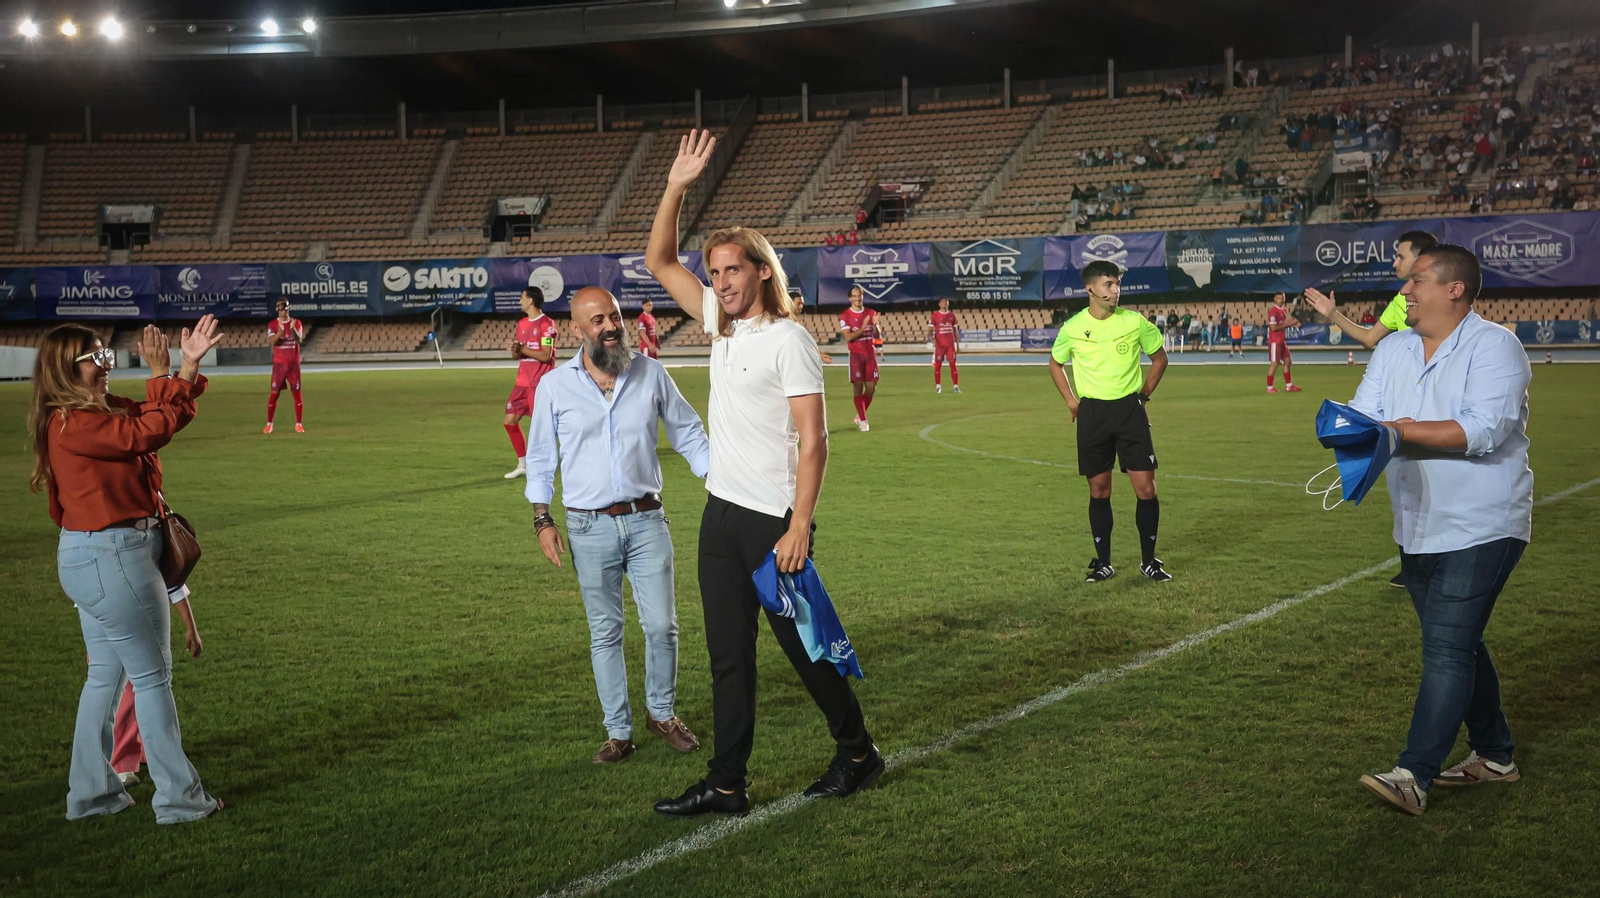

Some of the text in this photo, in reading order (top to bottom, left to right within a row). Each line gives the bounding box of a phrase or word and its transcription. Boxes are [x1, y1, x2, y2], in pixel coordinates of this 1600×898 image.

[1259, 235, 1285, 243] POTABLE
[1182, 248, 1209, 256] HIELOS
[1483, 243, 1563, 259] MASA-MADRE
[1177, 256, 1214, 264] GARRIDO
[845, 263, 909, 278] DSP
[954, 257, 1018, 276] MdR
[59, 285, 134, 299] JIMANG
[282, 279, 368, 299] neopolis.es
[158, 293, 230, 303] MONTEALTO
[385, 294, 404, 302] Hogar
[966, 292, 1012, 300] 655 08 15 01
